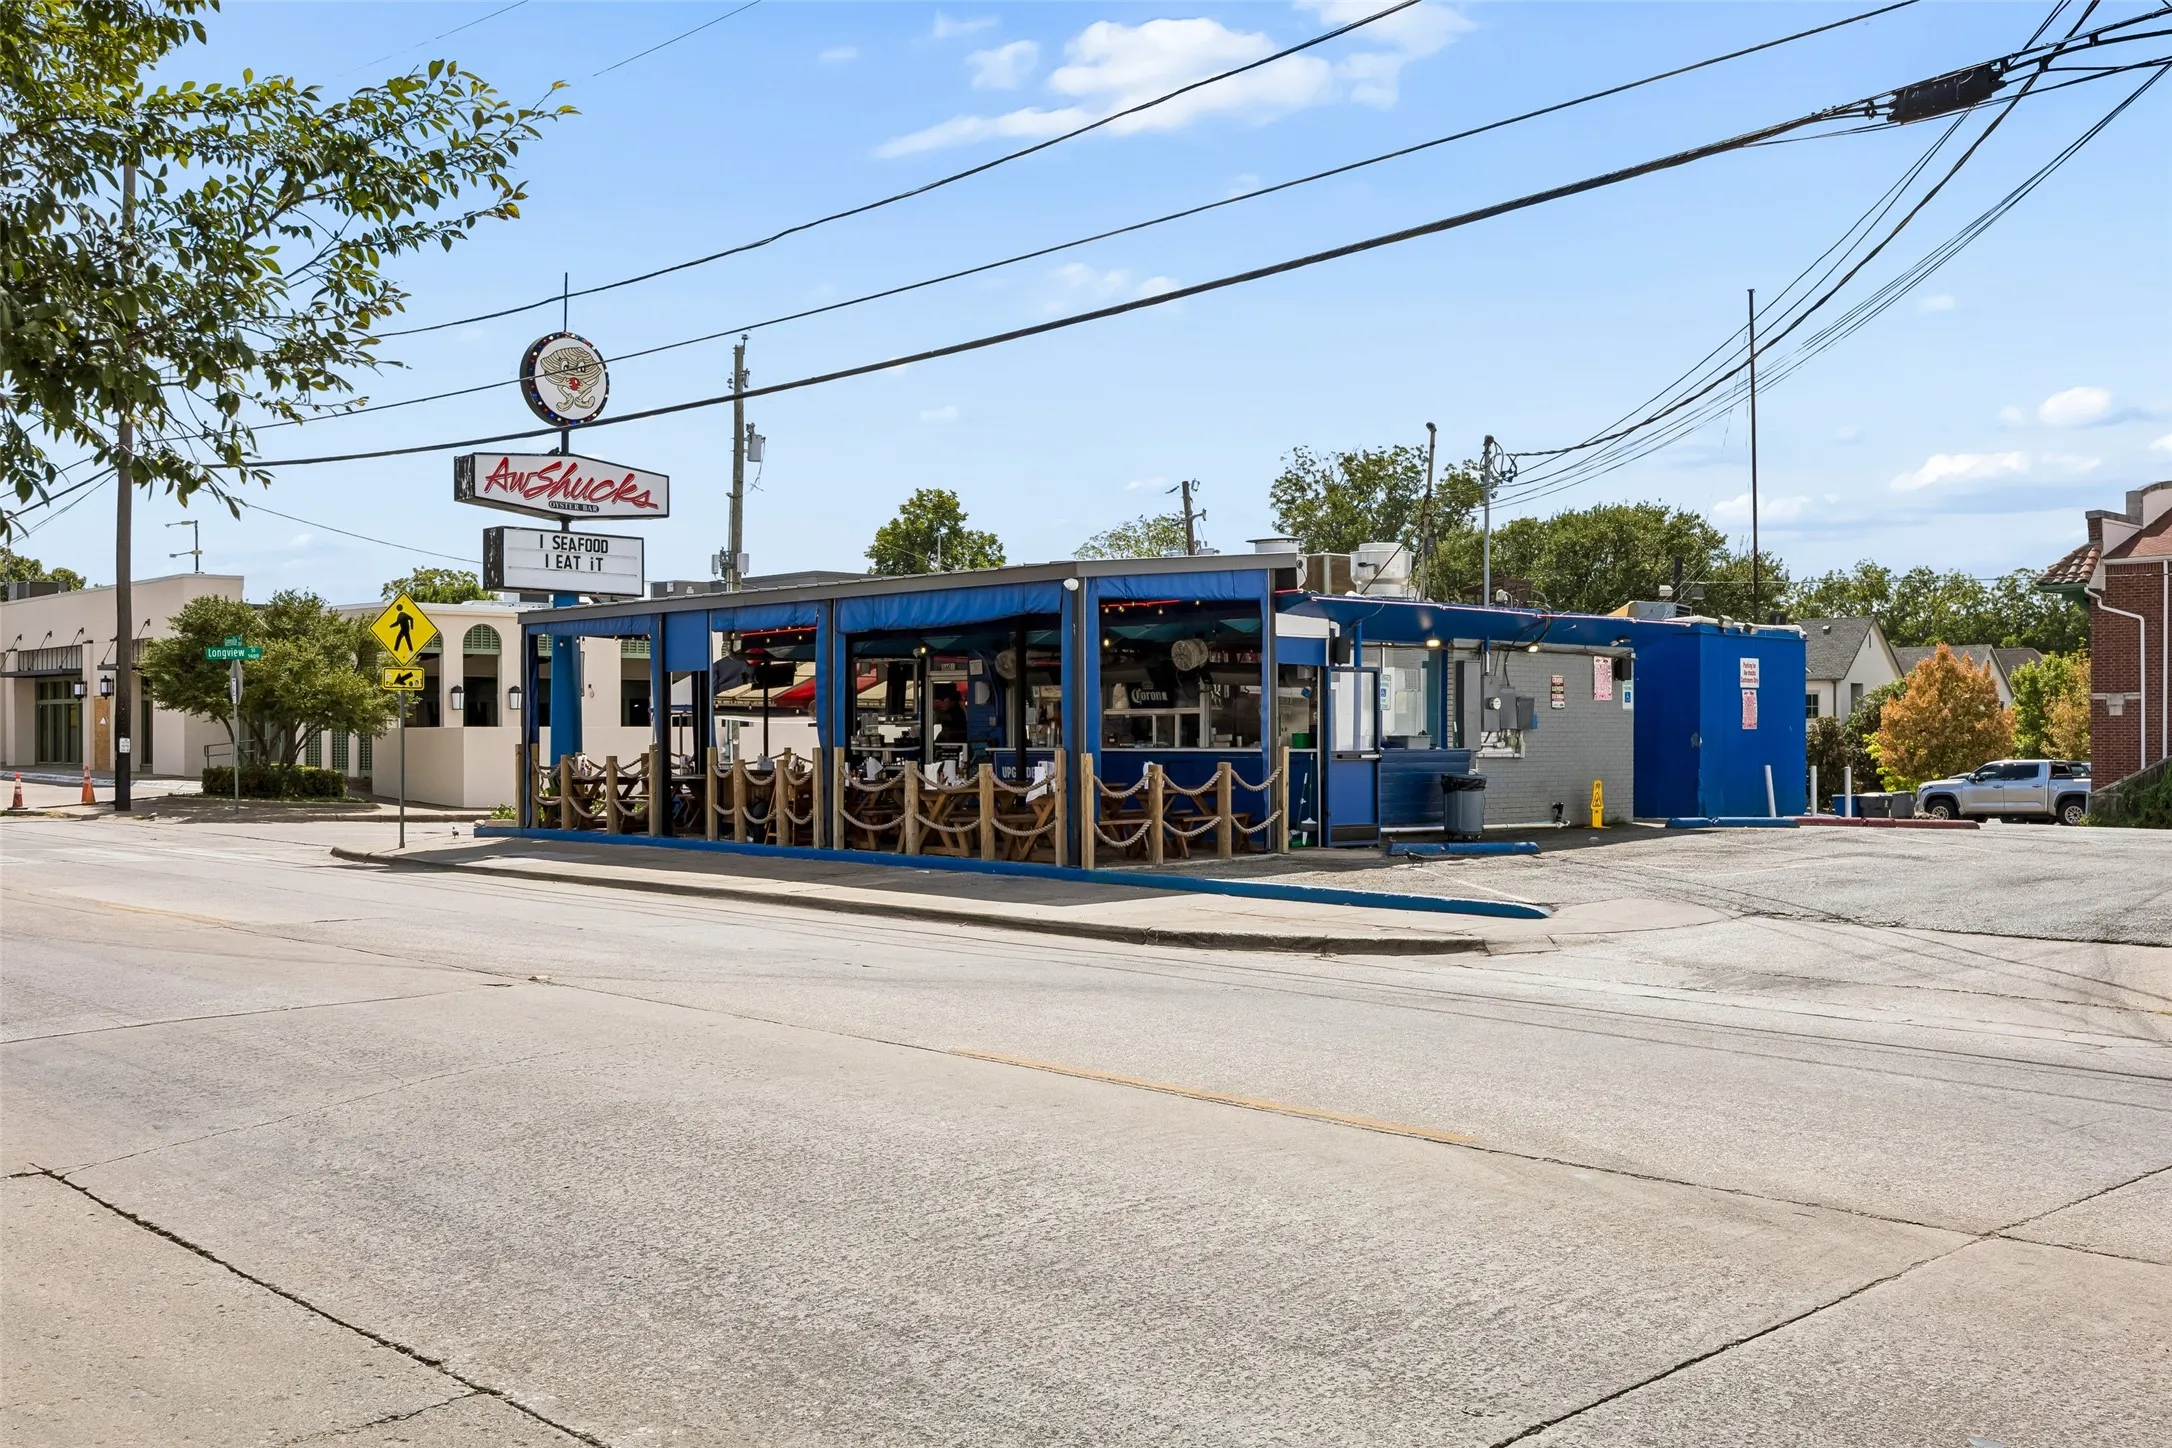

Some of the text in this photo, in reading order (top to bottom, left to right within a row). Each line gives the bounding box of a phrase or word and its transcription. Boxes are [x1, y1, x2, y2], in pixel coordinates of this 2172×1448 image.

[549, 502, 598, 513] OYSTER BAR
[539, 534, 609, 554] I SEAFOOD
[545, 554, 549, 569] I
[555, 555, 581, 570] EAT
[208, 647, 245, 660] Longview
[1131, 688, 1168, 705] Corona
